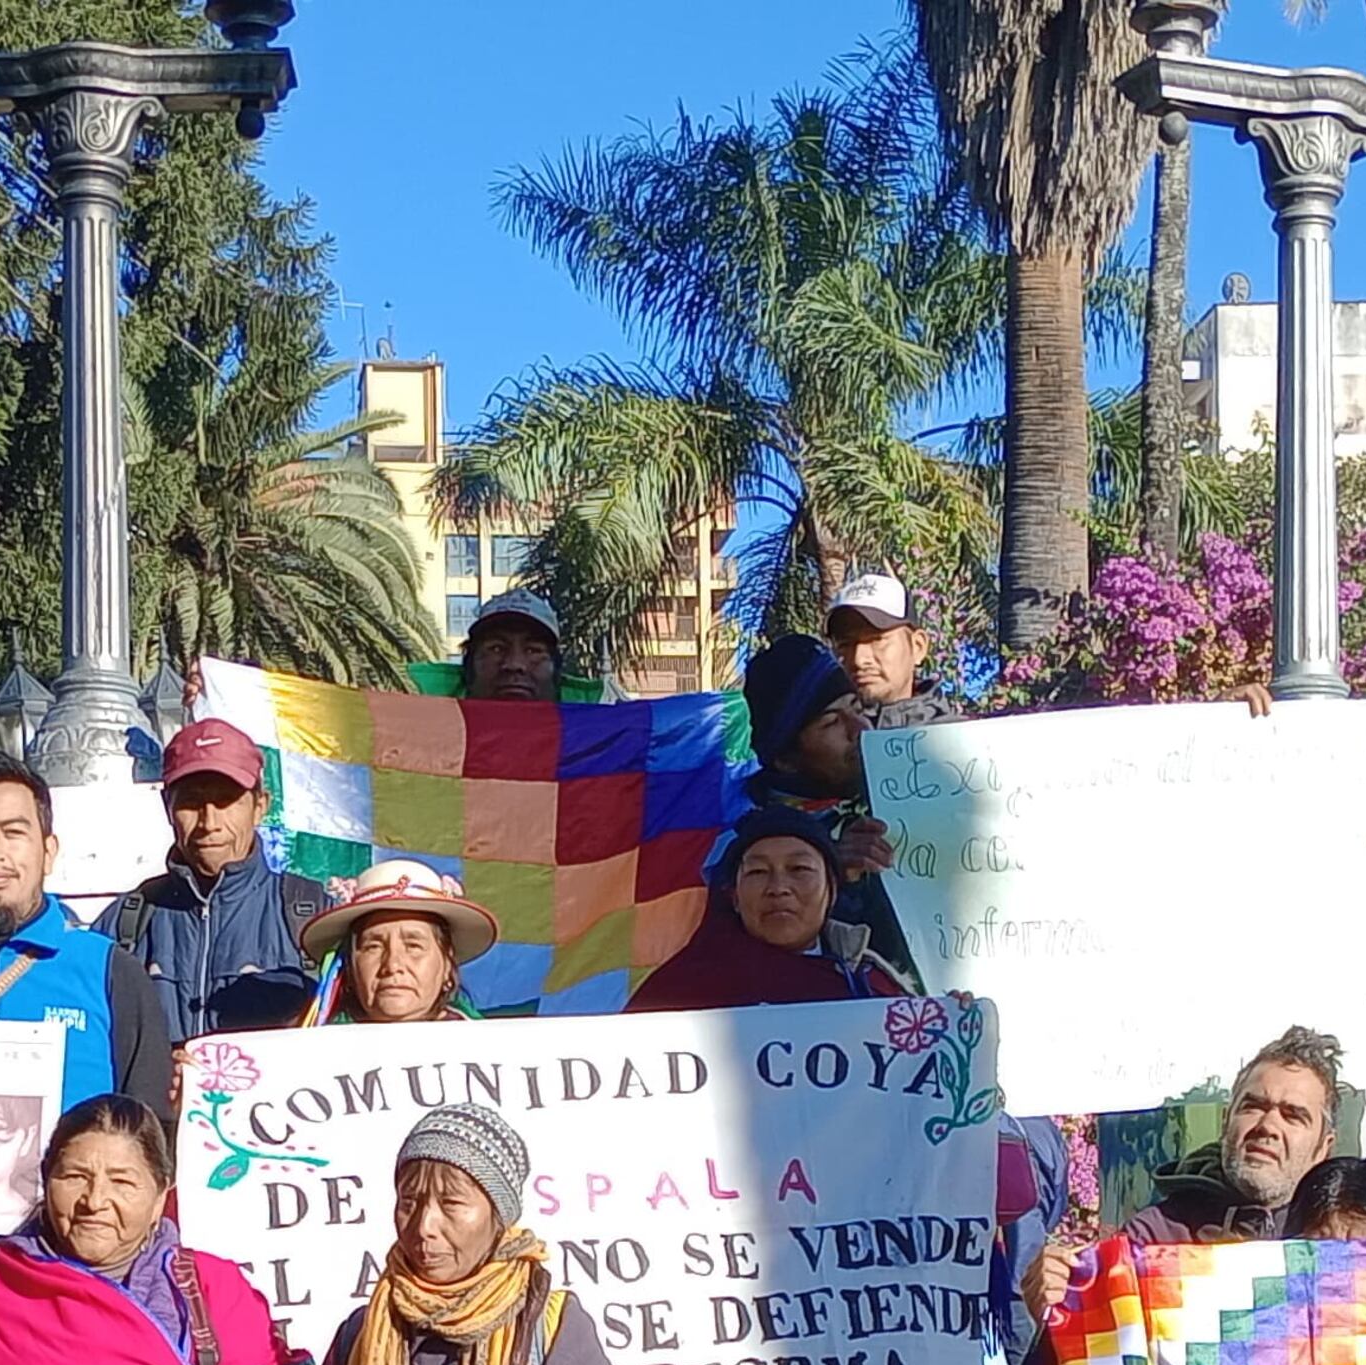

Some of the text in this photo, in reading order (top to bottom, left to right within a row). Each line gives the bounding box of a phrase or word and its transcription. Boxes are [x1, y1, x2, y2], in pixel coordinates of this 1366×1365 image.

[247, 1039, 946, 1146] COMUNIDAD COYA
[265, 1174, 367, 1231] DE
[558, 1238, 651, 1286] NO
[683, 1232, 760, 1280] SE
[789, 1215, 990, 1274] VENDE
[603, 1284, 989, 1353] SE DEFIENDE
